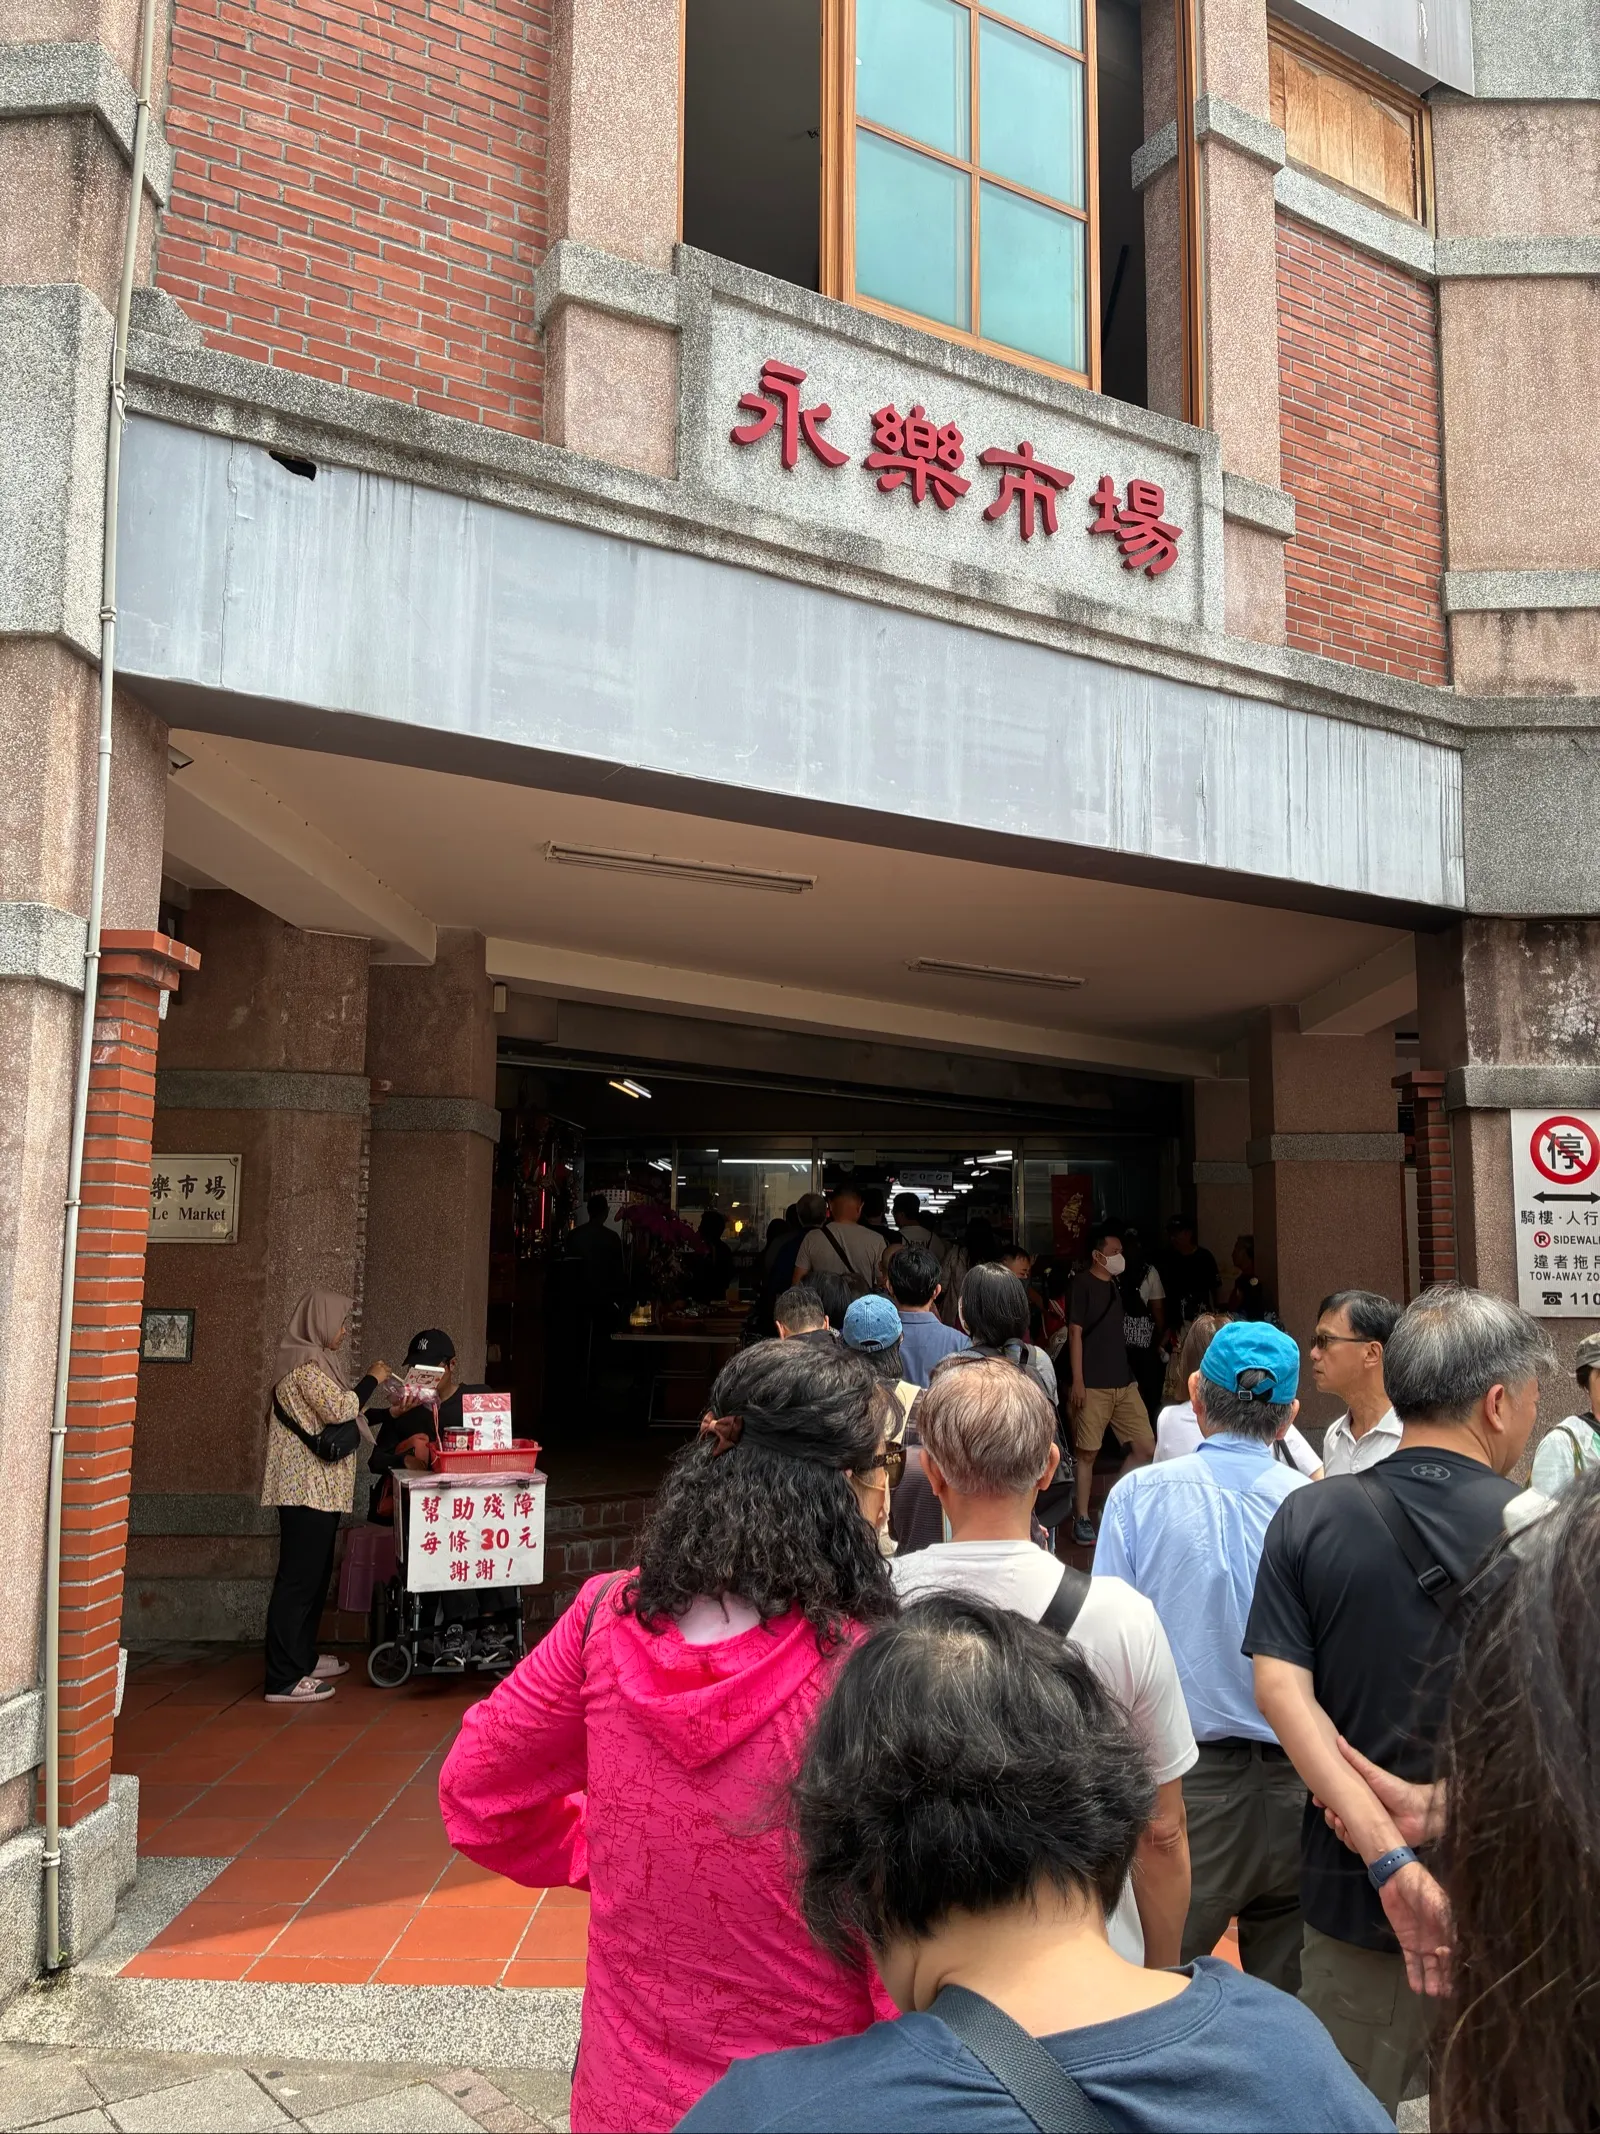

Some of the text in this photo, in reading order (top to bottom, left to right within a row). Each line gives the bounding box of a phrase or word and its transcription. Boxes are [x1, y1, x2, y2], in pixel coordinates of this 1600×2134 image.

[729, 359, 1184, 577] 永樂市場
[1547, 1132, 1584, 1170] 停
[150, 1173, 227, 1200] 樂市場
[152, 1206, 226, 1221] Le Market
[1553, 1235, 1600, 1245] SIDEWAL
[1529, 1271, 1582, 1281] TOW-AWAY
[471, 1395, 502, 1411] 愛心
[420, 1526, 537, 1555] 每條30元
